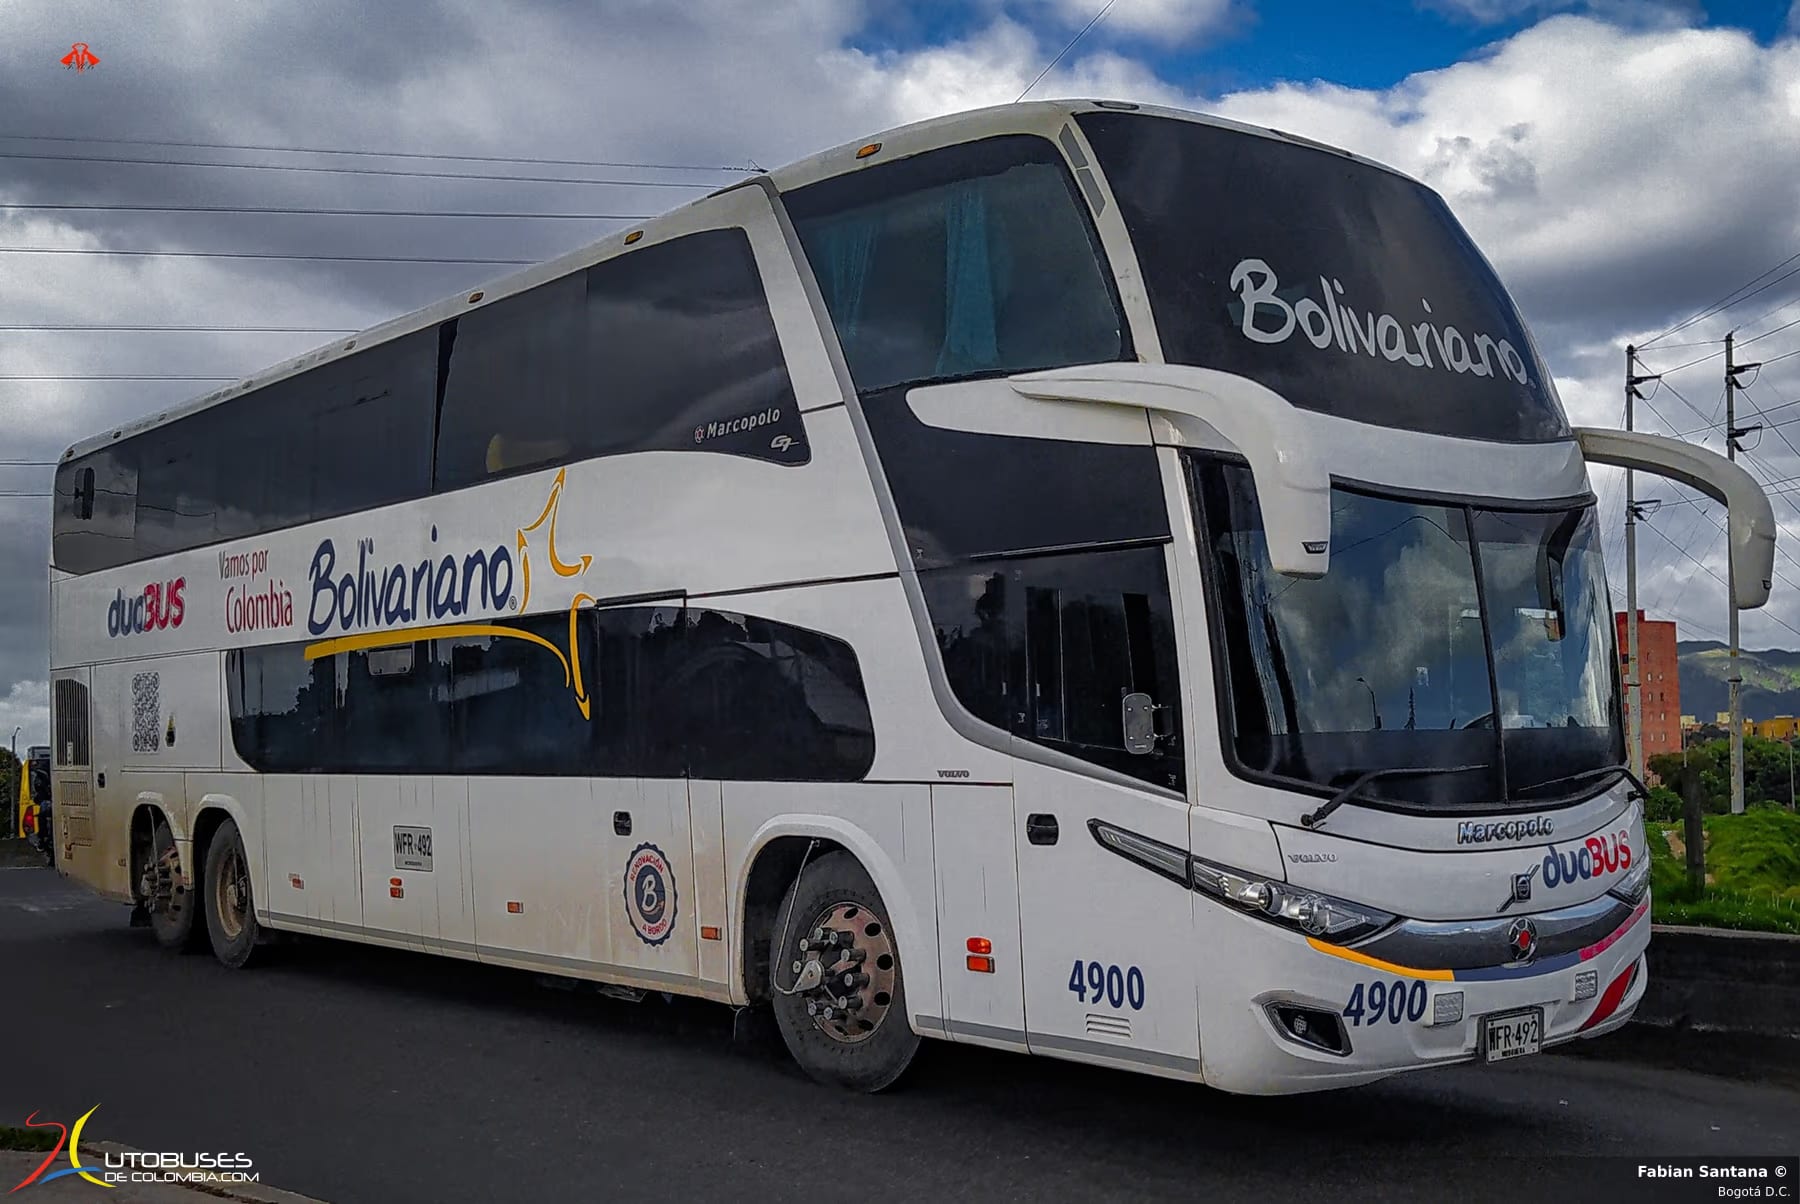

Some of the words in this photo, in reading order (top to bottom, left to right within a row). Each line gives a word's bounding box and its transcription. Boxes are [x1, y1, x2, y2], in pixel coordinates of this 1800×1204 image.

[1230, 258, 1528, 385] Bolivariano
[706, 408, 780, 438] Marcopolo
[218, 551, 249, 580] Vamos
[251, 549, 269, 581] por
[308, 525, 513, 635] Bolivariano
[225, 579, 293, 634] Colombia
[937, 769, 970, 778] VOLVO
[1457, 816, 1555, 845] Marcopolo
[1287, 853, 1338, 864] VOLVO
[1068, 959, 1145, 1011] 4900
[1342, 979, 1428, 1027] 4900
